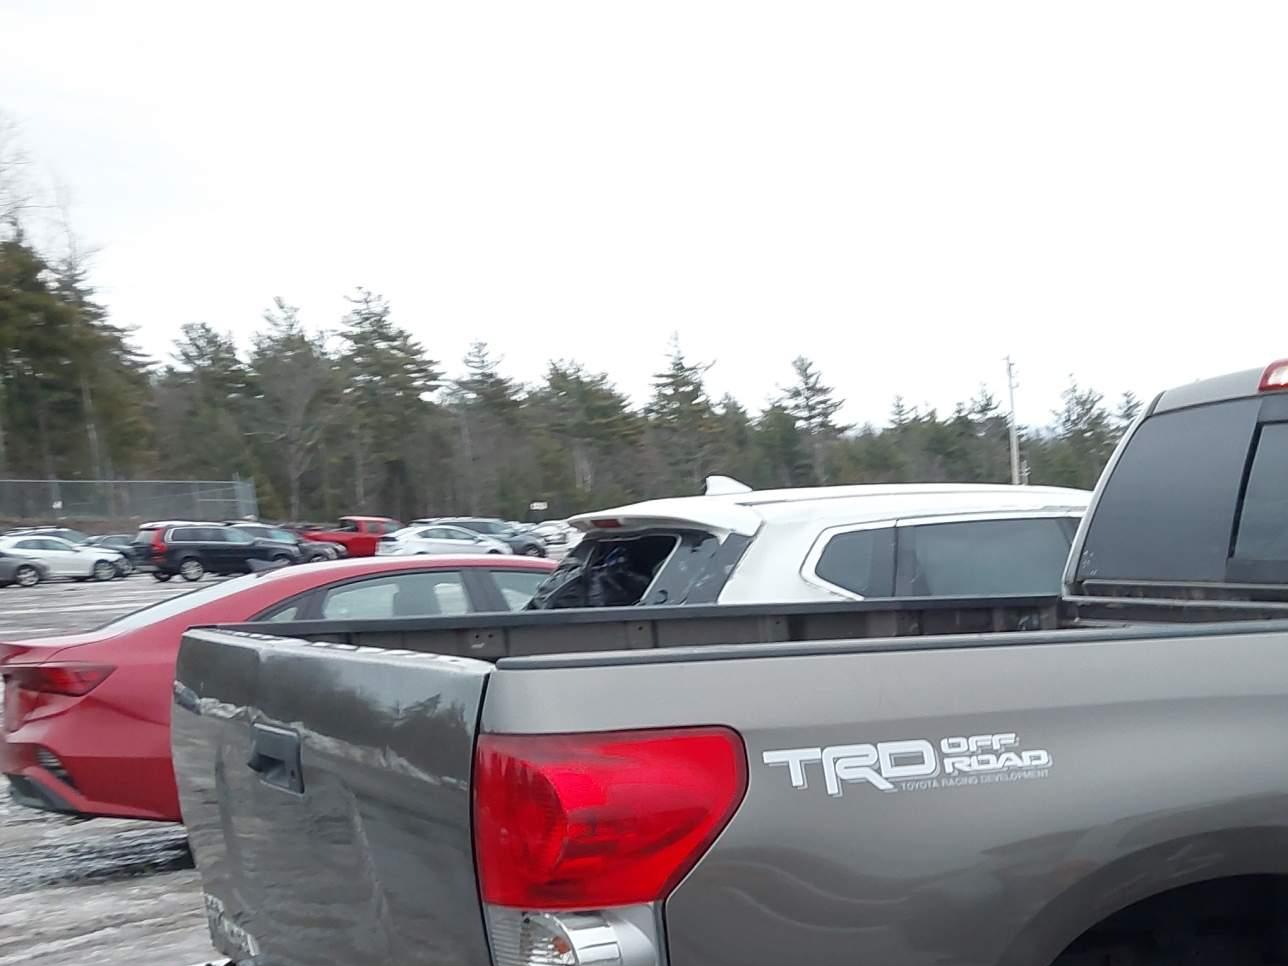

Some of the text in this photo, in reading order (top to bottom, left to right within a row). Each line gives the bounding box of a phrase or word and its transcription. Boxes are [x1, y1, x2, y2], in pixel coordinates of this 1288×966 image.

[940, 732, 1019, 755] OFF
[762, 738, 939, 796] TRD
[942, 749, 1052, 777] ROAD
[901, 768, 1050, 791] TOYOTA RACING DEVELOPMENT
